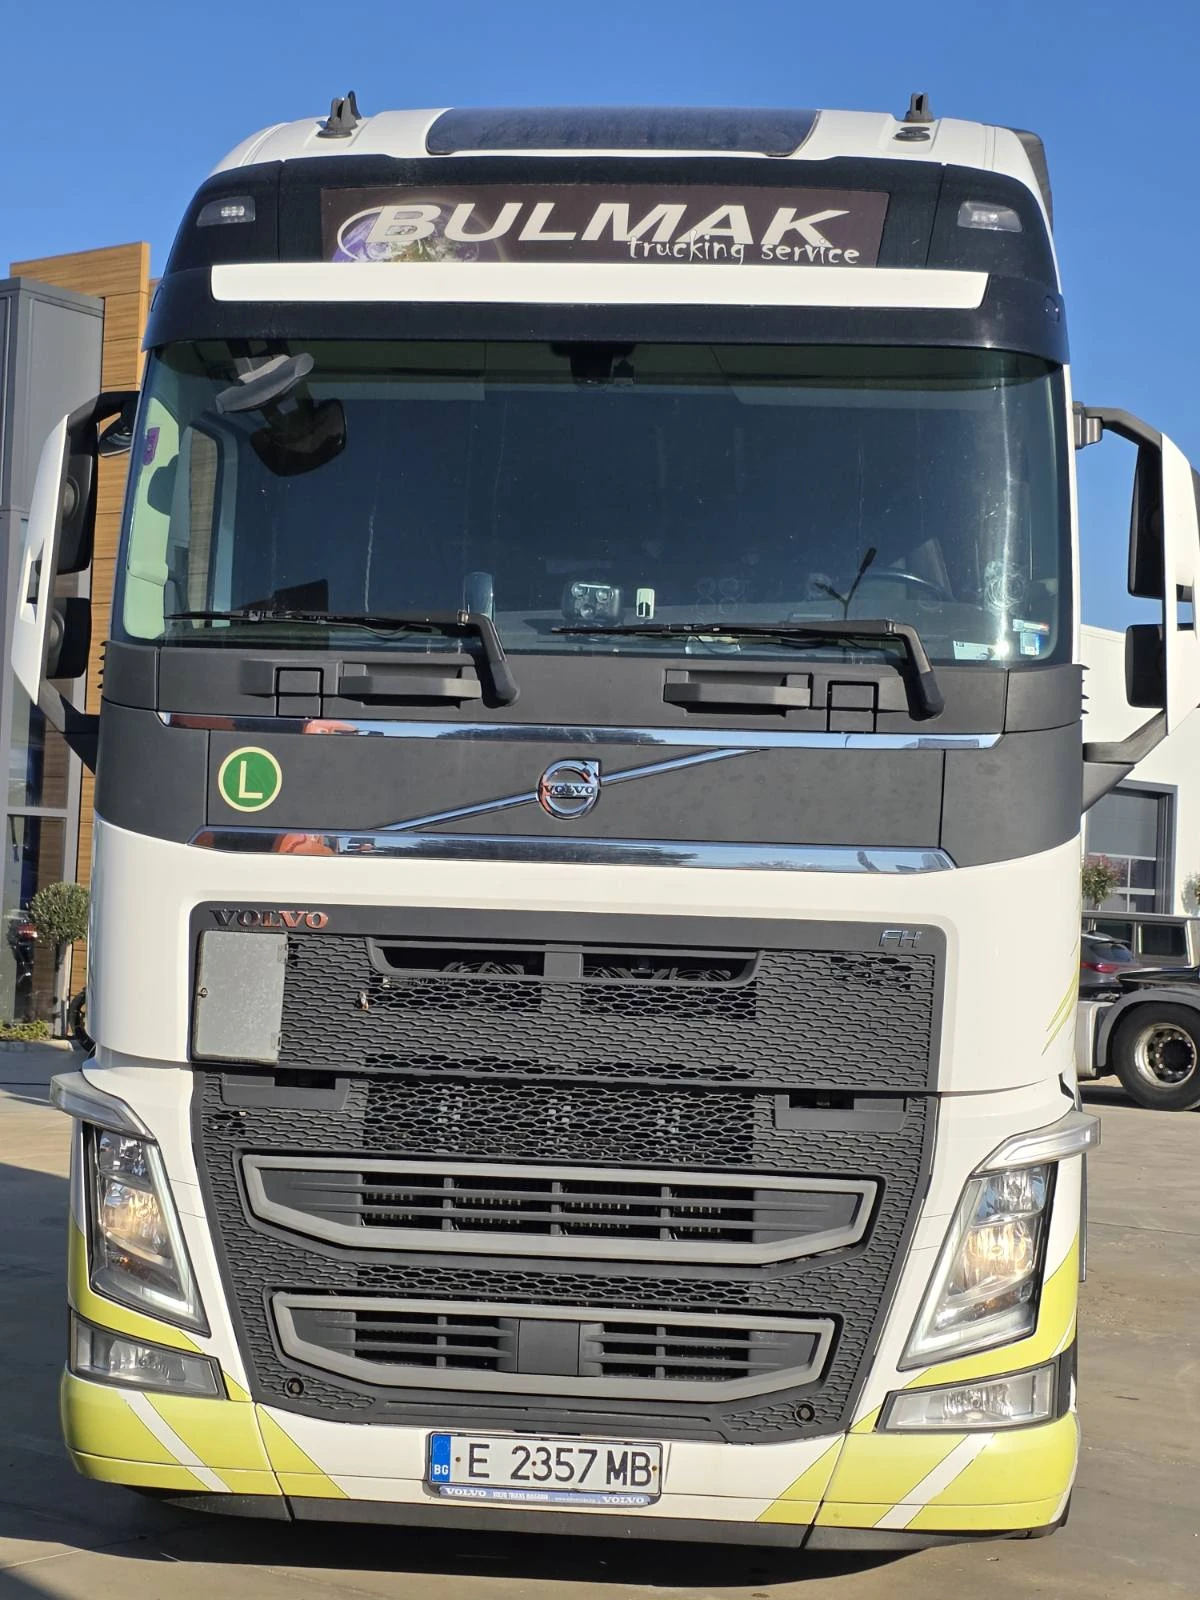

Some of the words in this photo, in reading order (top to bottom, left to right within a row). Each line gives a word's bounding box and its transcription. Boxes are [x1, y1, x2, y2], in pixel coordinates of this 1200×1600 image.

[365, 202, 850, 248] BULMAK
[627, 230, 745, 265] trucking
[761, 238, 860, 264] service
[238, 760, 263, 799] L
[543, 784, 595, 795] VOLVO
[209, 908, 329, 929] VOLVO
[879, 929, 922, 948] FH
[433, 1463, 449, 1475] BG
[467, 1442, 490, 1479] E
[510, 1445, 598, 1484] 2357
[605, 1449, 651, 1487] MB
[445, 1487, 487, 1497] VOLVO
[602, 1496, 645, 1504] VOLVO
